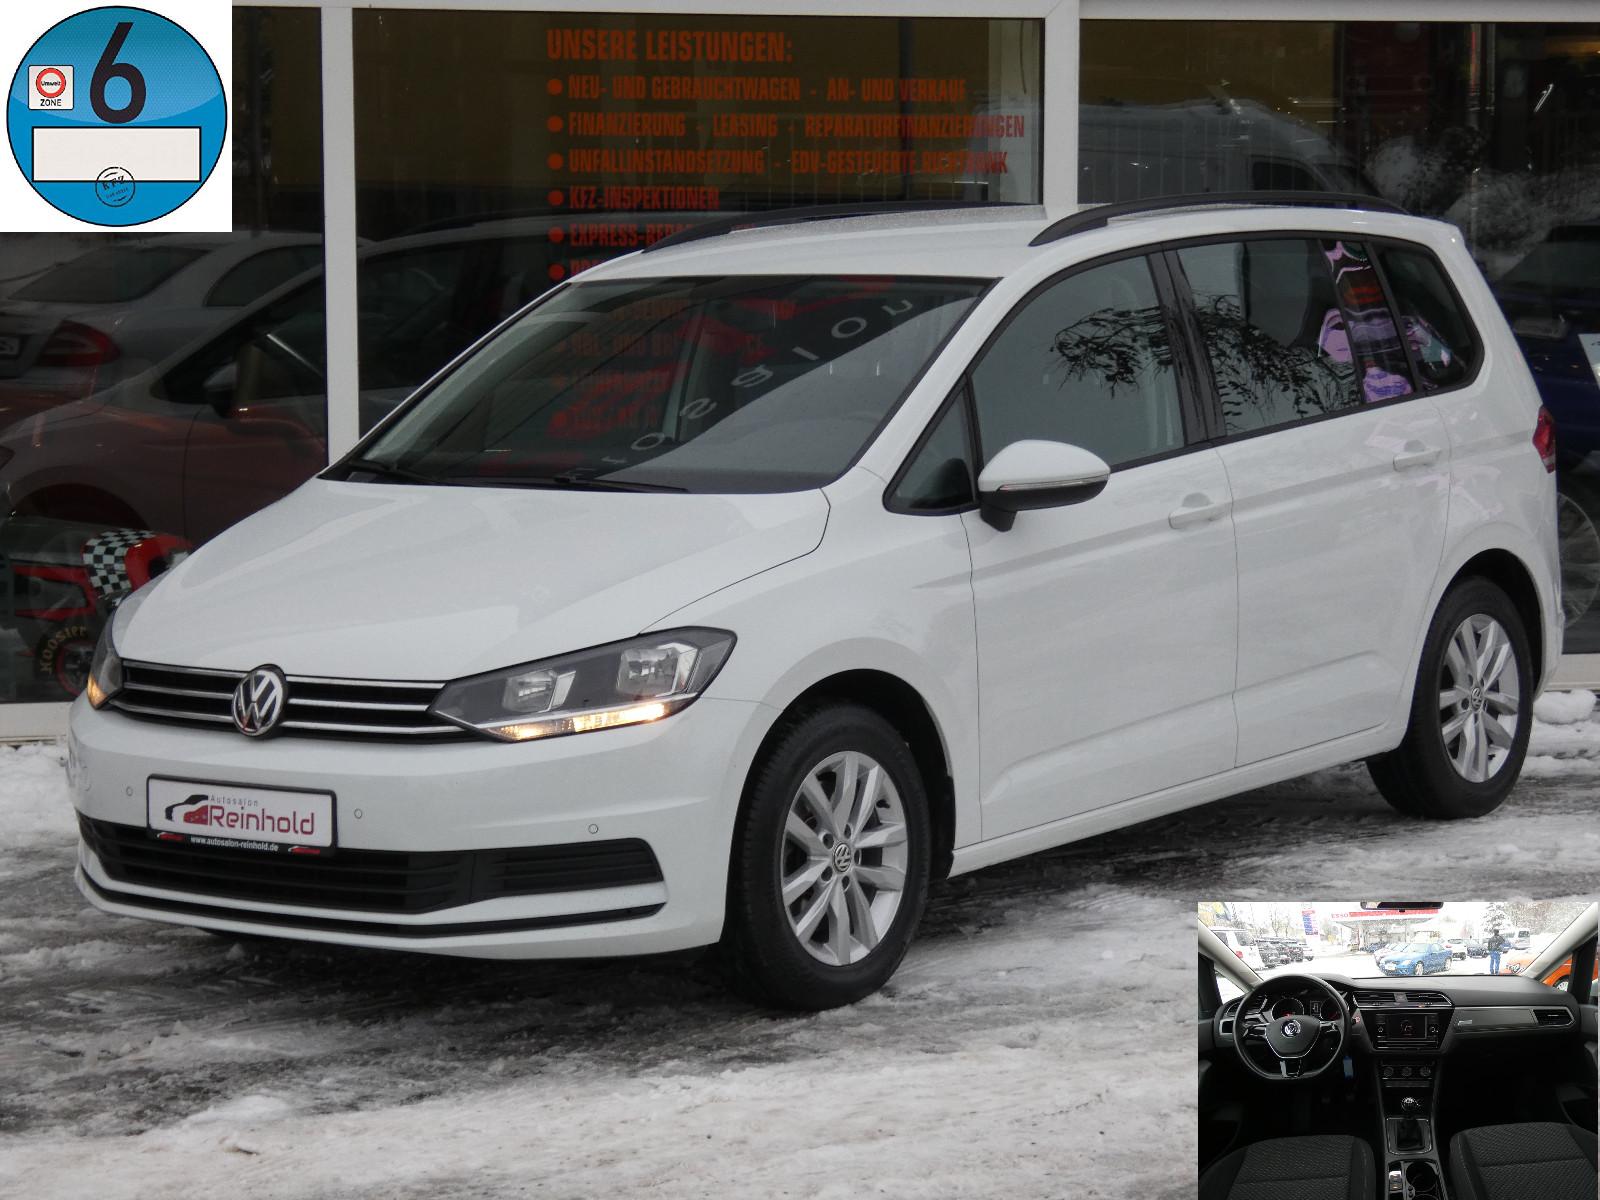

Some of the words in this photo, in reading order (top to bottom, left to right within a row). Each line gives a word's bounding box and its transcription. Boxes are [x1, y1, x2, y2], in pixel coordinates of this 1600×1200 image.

[546, 29, 638, 61] UNSERE
[645, 31, 793, 62] LEISTUNGEN:
[568, 75, 608, 99] NEU-
[612, 76, 647, 99] UND
[651, 76, 800, 100] GEBRAUCHTWAGEN
[861, 79, 895, 101] UND
[900, 79, 967, 101] VERKAUF
[568, 112, 686, 137] FINANZIERUNG
[712, 113, 778, 137] LEASING
[805, 114, 1025, 138] REPARATURFINANZIERUNGEN
[568, 149, 766, 175] UNFALLINSTANDSETZUNG
[569, 185, 720, 209] KFZ-INSPEKTIONEN
[210, 795, 259, 808] Autosalon
[209, 805, 315, 836] Reinhold
[190, 835, 279, 852] www.autosalon-reinhold.de
